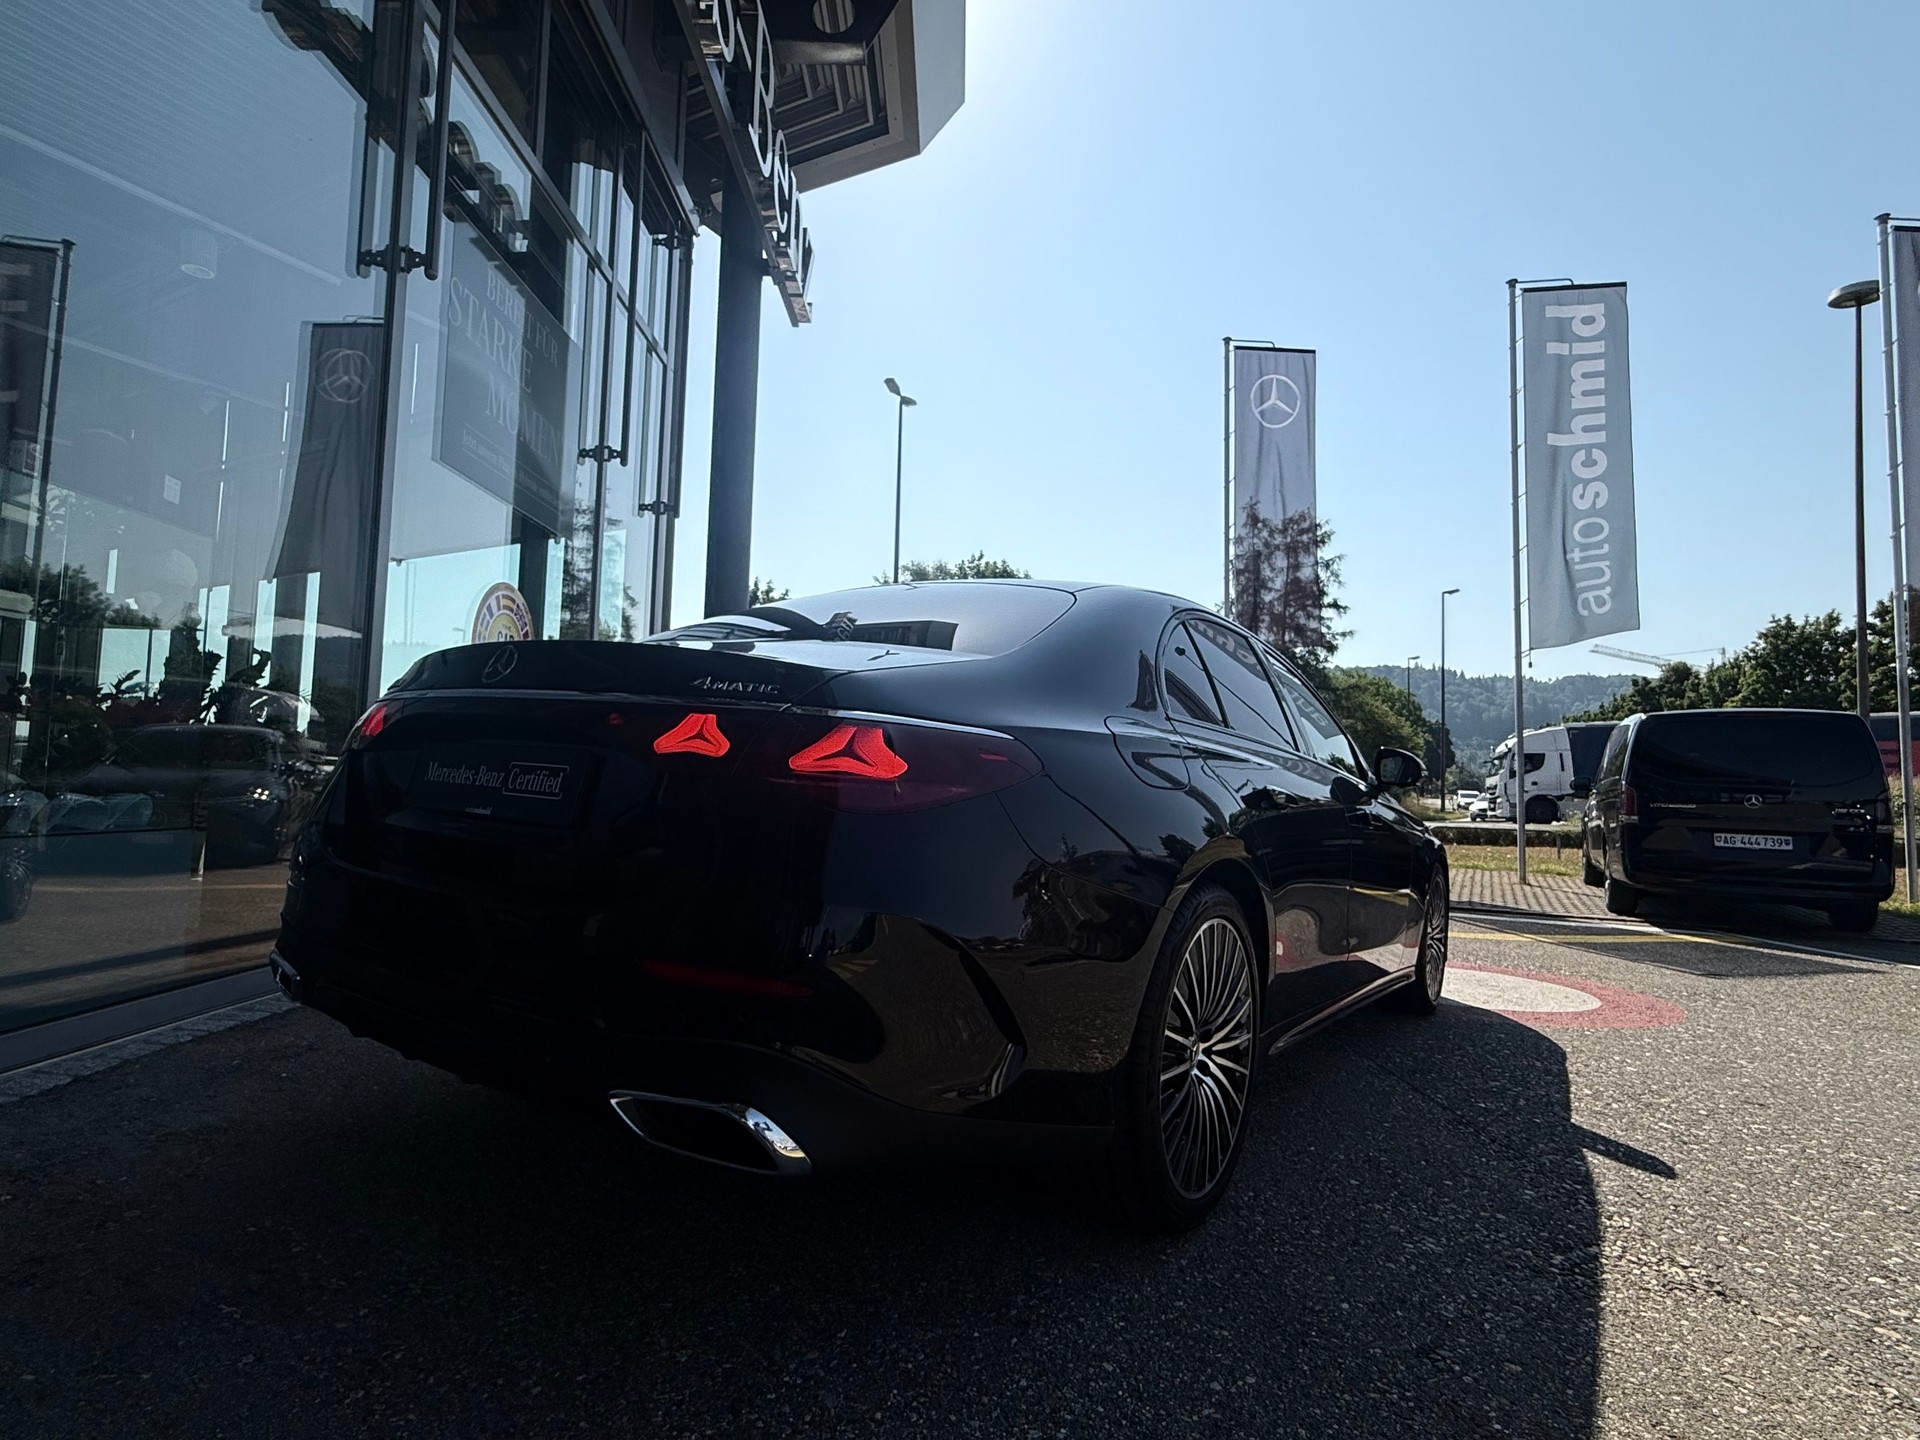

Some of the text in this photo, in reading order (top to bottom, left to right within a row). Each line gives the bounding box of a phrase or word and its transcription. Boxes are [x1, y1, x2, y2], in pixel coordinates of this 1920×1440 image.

[449, 276, 534, 392] STARKE
[1545, 302, 1611, 617] autoschmid
[689, 676, 781, 695] 4MATIC
[424, 761, 564, 794] Mercedes-Benz Certified
